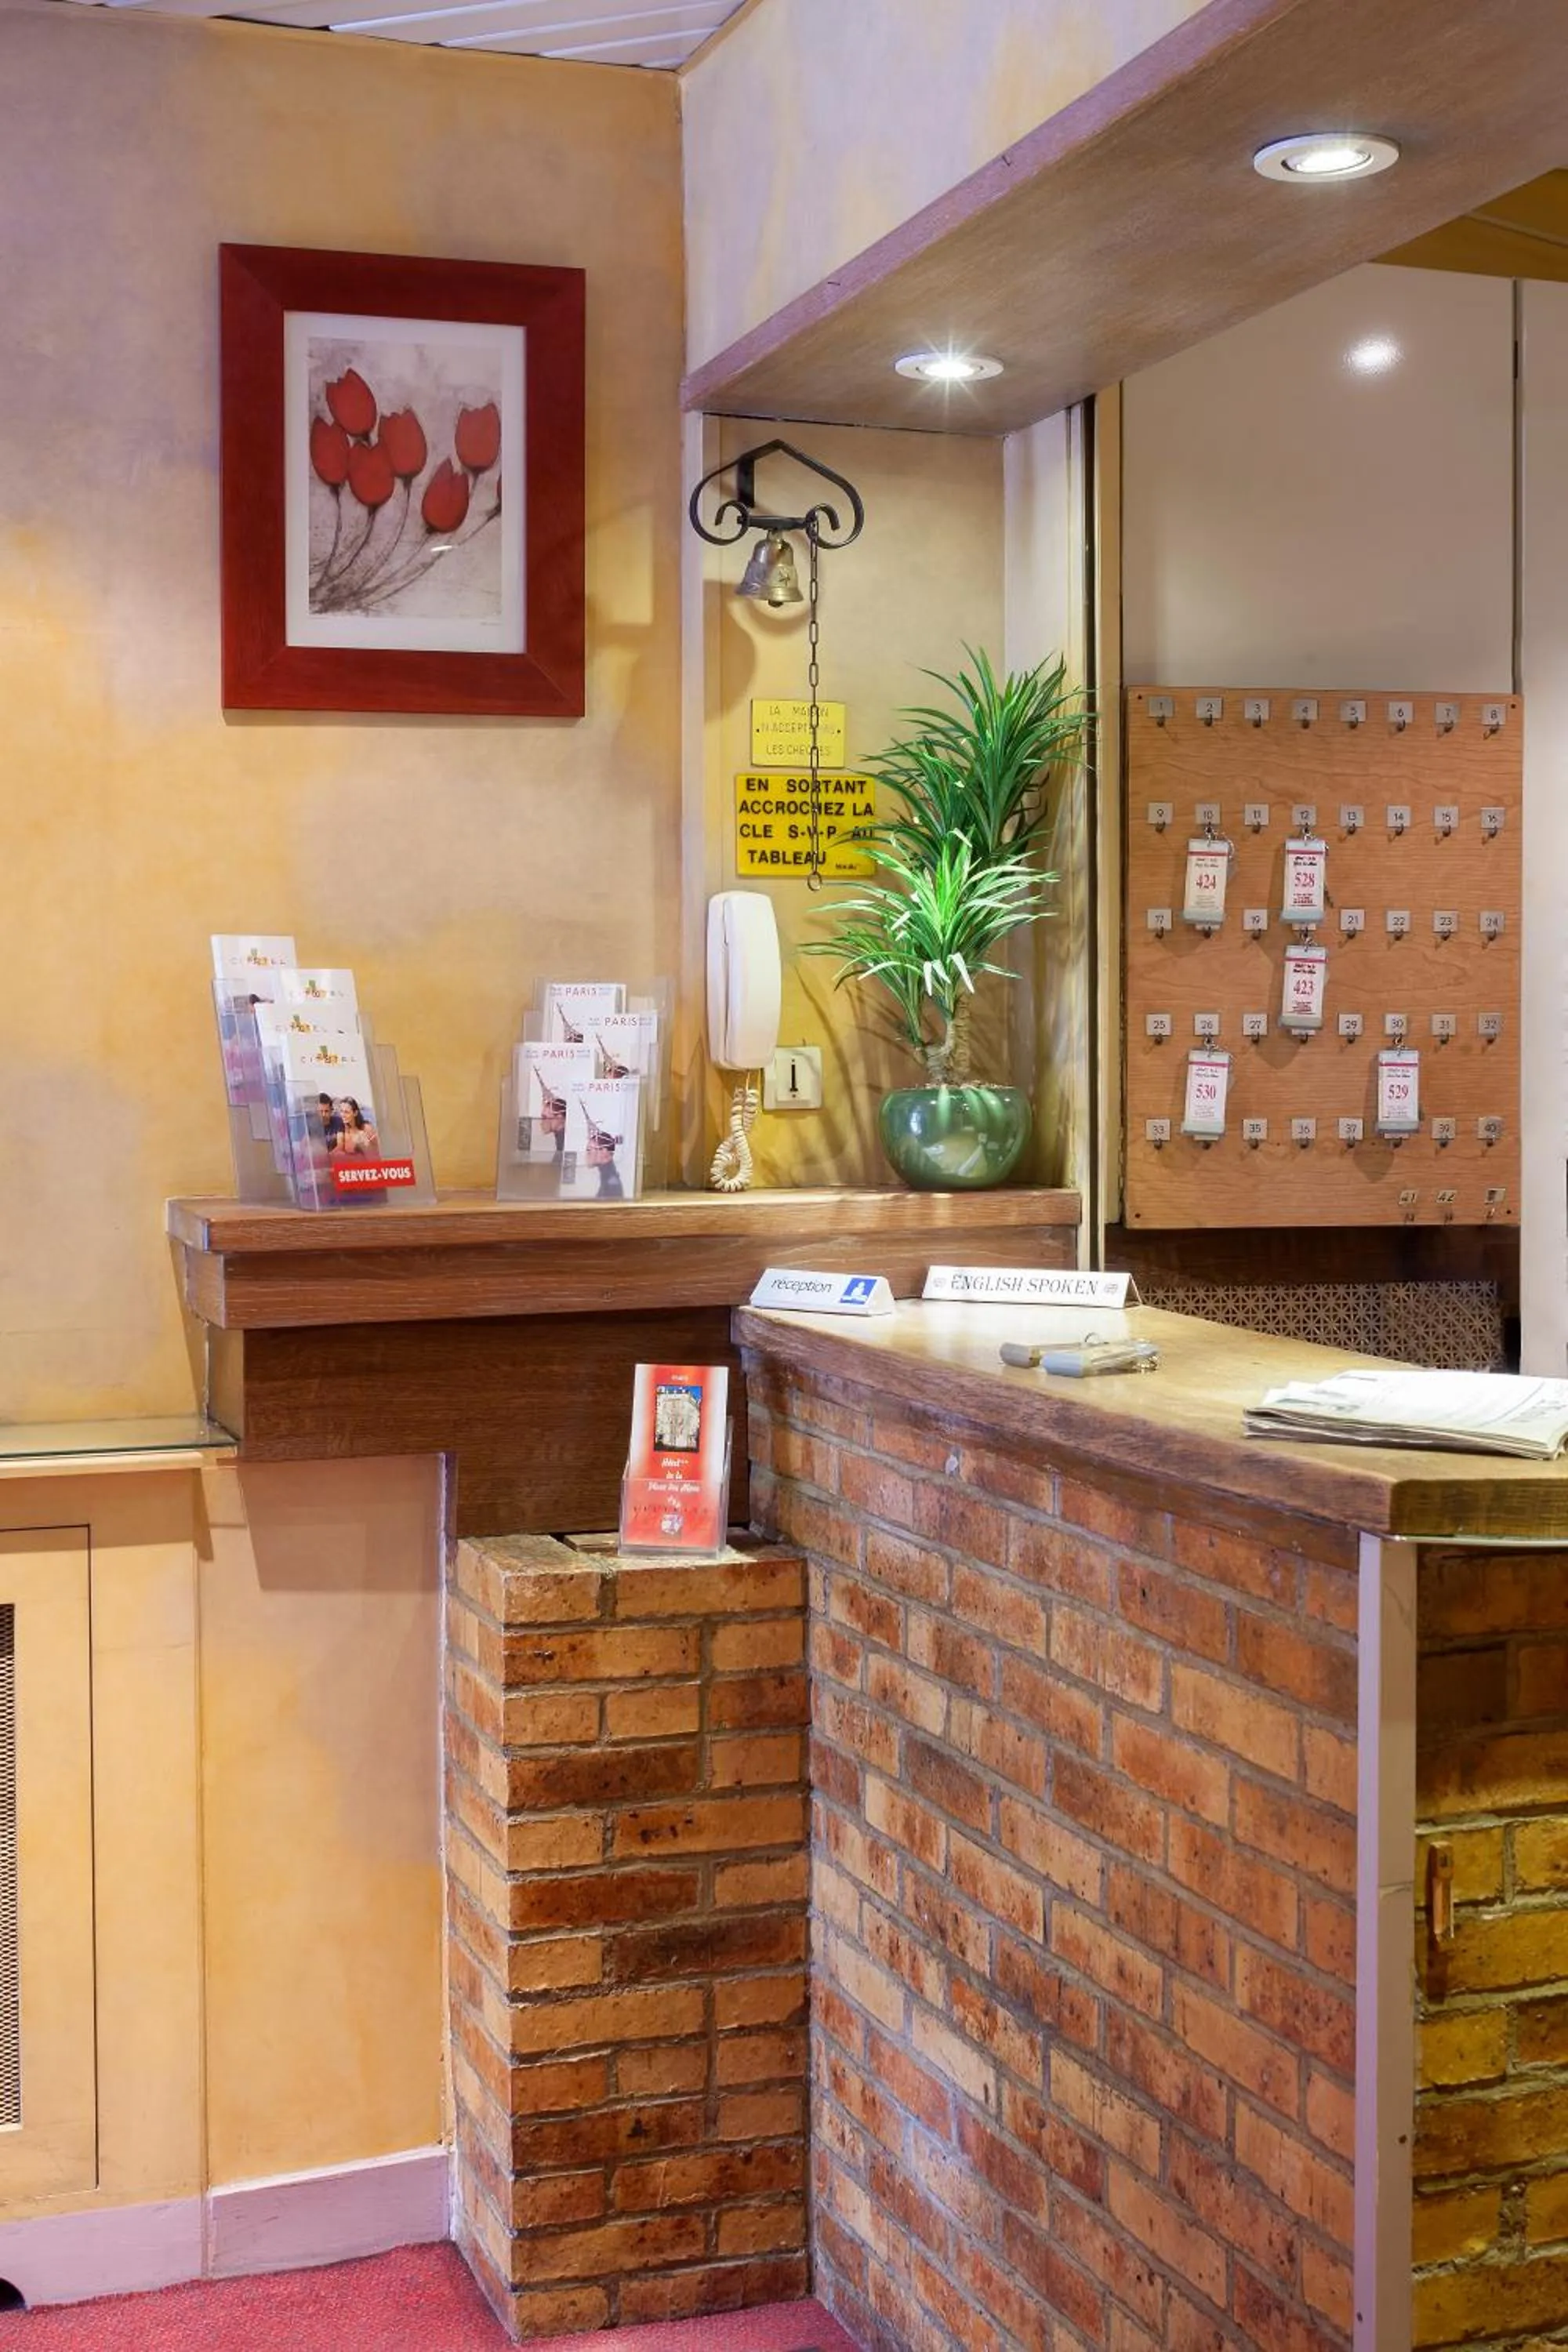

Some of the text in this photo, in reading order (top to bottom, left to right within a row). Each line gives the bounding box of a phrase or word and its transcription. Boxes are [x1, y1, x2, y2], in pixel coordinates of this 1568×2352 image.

[746, 778, 866, 794] EN SORTANT
[739, 800, 874, 816] ACCROCHEZ LA
[739, 823, 773, 838] CLE
[747, 850, 826, 866] TABLEAU
[1196, 873, 1217, 890] 424
[1294, 872, 1315, 887] 528
[1348, 915, 1359, 925] 21
[1392, 916, 1406, 926] 22
[1439, 916, 1453, 926] 23
[565, 987, 597, 996] PARIS
[1293, 979, 1314, 996] 423
[604, 1017, 638, 1026] PARIS
[1153, 1020, 1166, 1029] 25
[1200, 1019, 1213, 1029] 26
[1249, 1019, 1261, 1029] 27
[1345, 1020, 1357, 1029] 29
[542, 1050, 575, 1059] PARIS
[589, 1083, 620, 1092] PARIS
[1196, 1083, 1217, 1100] 530
[1388, 1083, 1410, 1100] 529
[1249, 1123, 1261, 1133] 35
[338, 1165, 412, 1183] SERVEZ-VOUS
[951, 1273, 1098, 1296] ENGLISH SPOKEN
